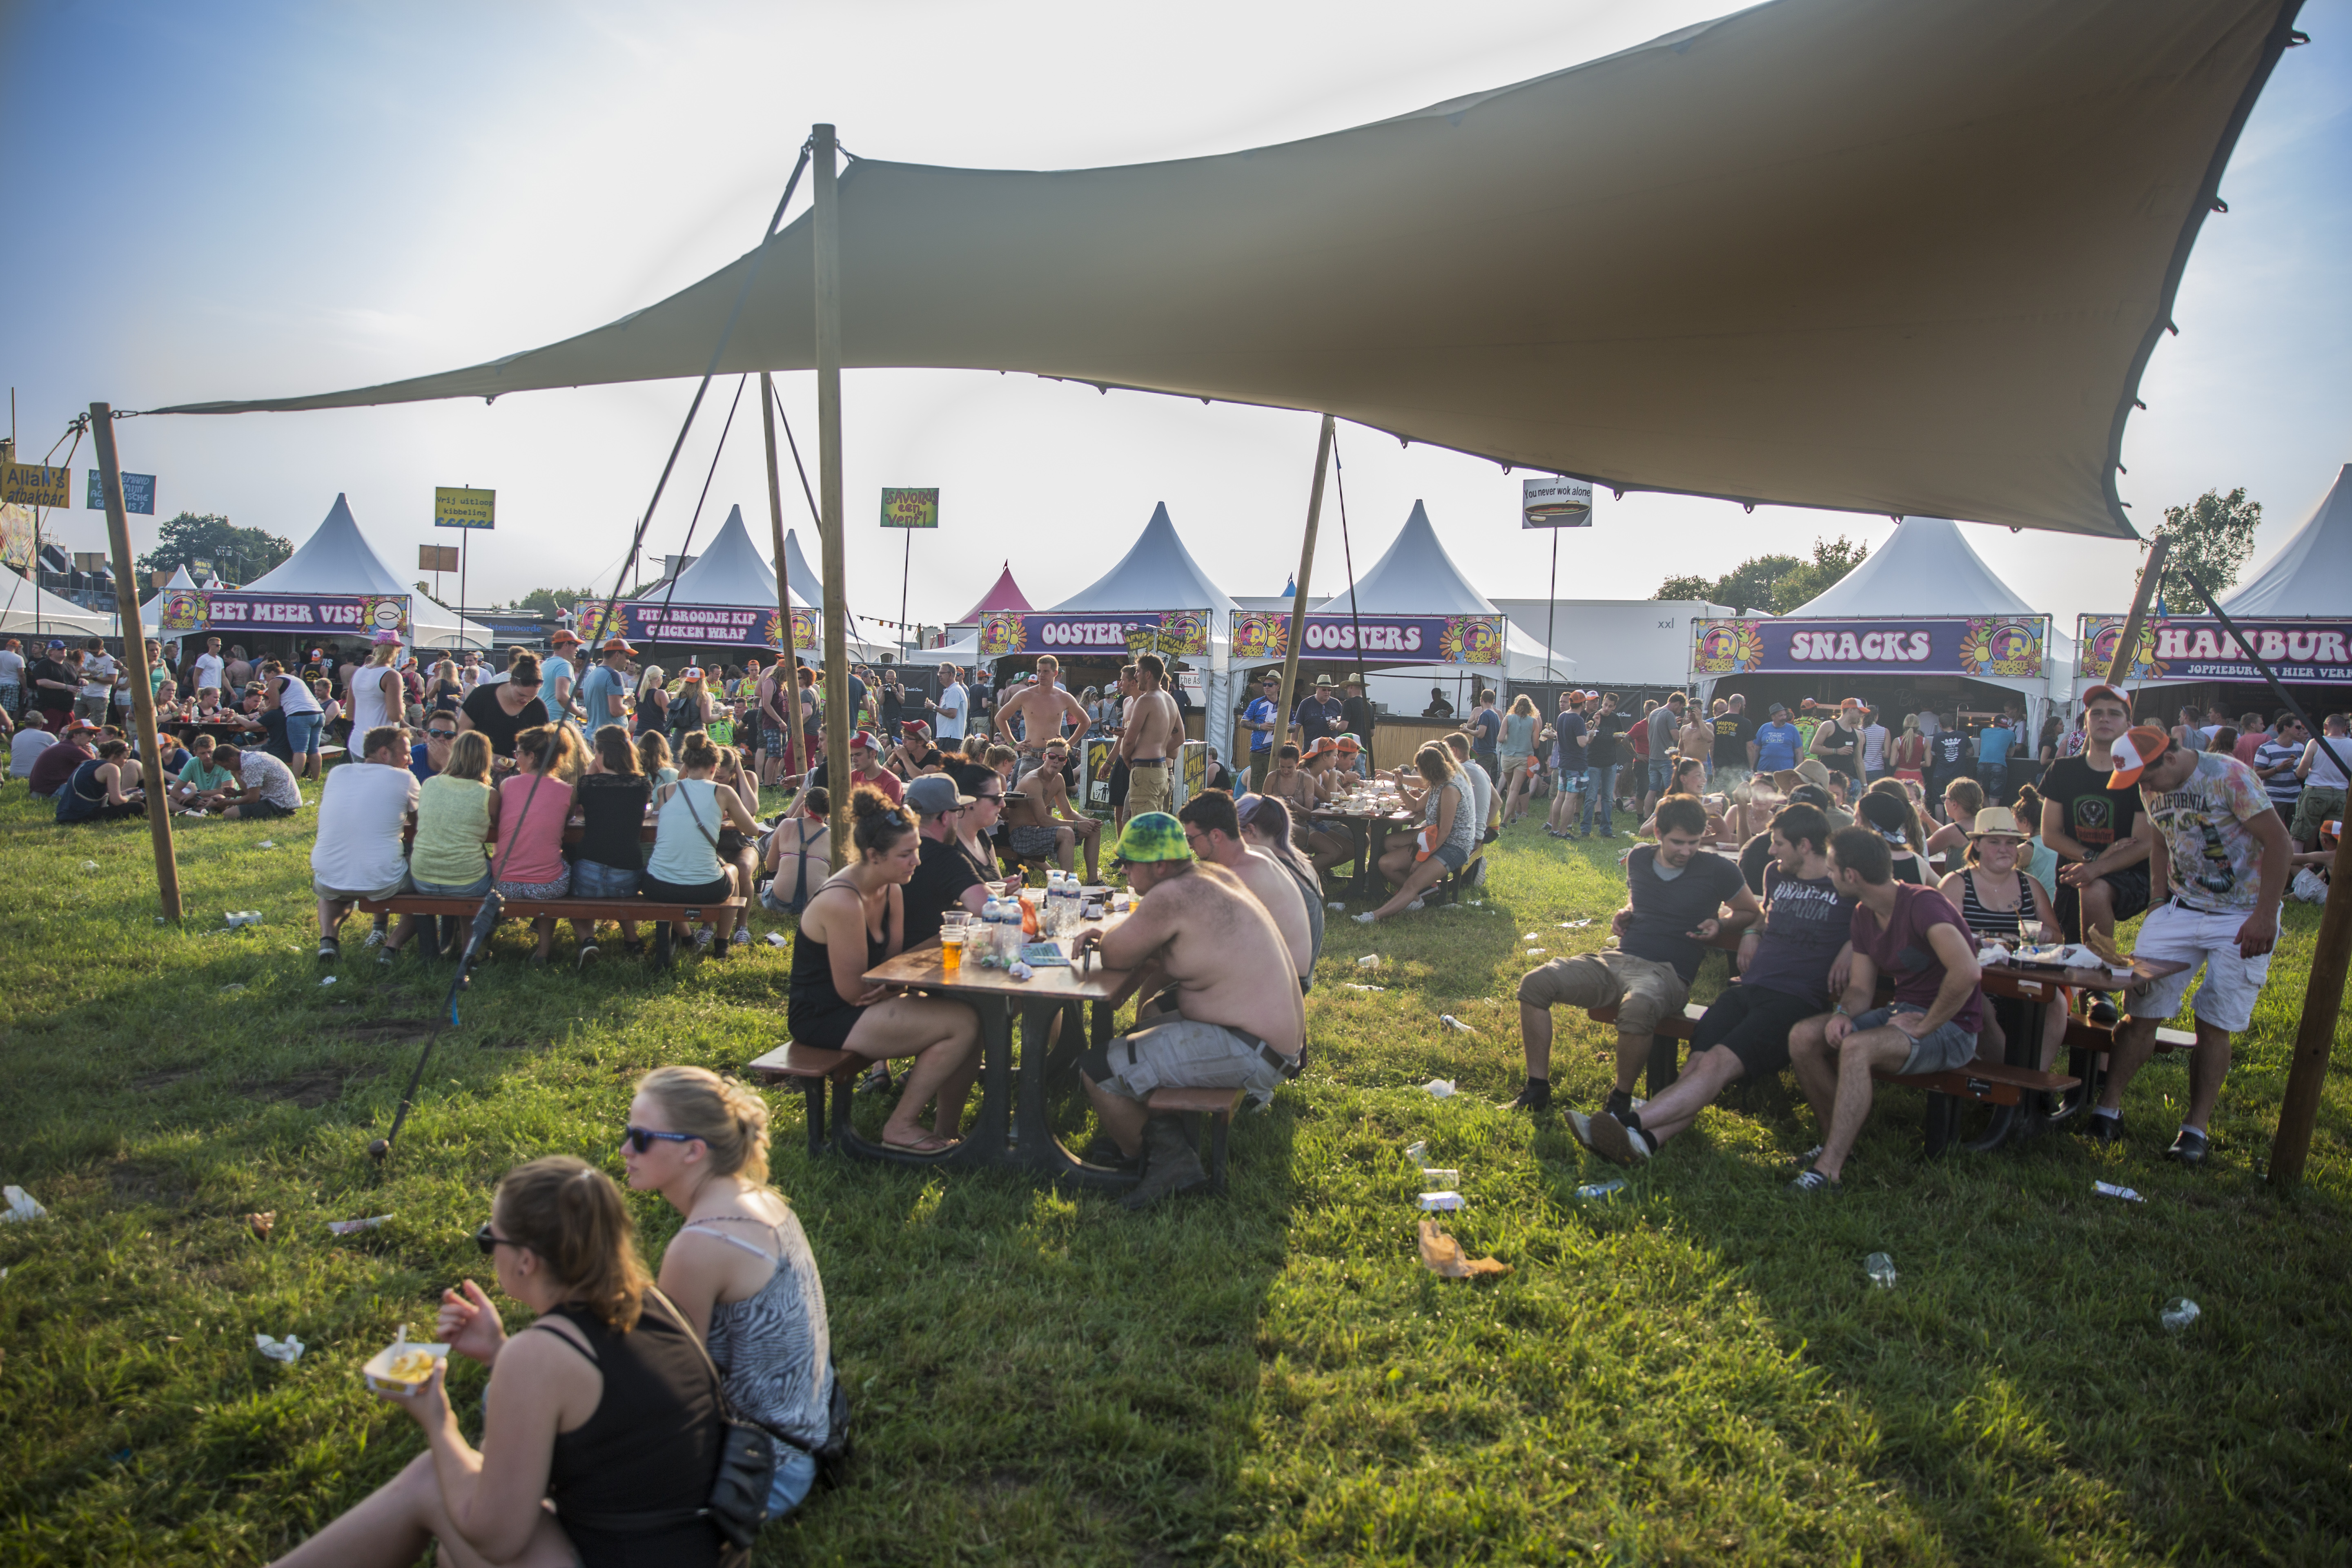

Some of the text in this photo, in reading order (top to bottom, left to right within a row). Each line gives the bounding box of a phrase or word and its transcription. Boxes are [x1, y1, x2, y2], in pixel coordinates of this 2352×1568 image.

[121, 474, 150, 486] EMAND
[1524, 486, 1590, 499] You never wok alone
[437, 497, 494, 507] Vrij uitloop
[444, 508, 487, 517] kibbeling
[898, 503, 923, 516] een
[885, 511, 927, 528] vent!
[209, 601, 364, 625] EET MEER VIS!
[671, 610, 729, 624] BROODJE
[731, 612, 756, 625] KIP
[1657, 617, 1674, 629] xxl
[647, 625, 747, 639] CHICKEN WRAP
[1306, 625, 1421, 651] OOSTERS
[1791, 632, 1929, 660] SNACKS
[2156, 630, 2352, 662] HAMBUR
[2187, 665, 2278, 676] JOPPIEBURGR
[2282, 667, 2315, 677] HIER
[1180, 676, 1191, 684] the
[2150, 792, 2212, 815] CALIFORNIA
